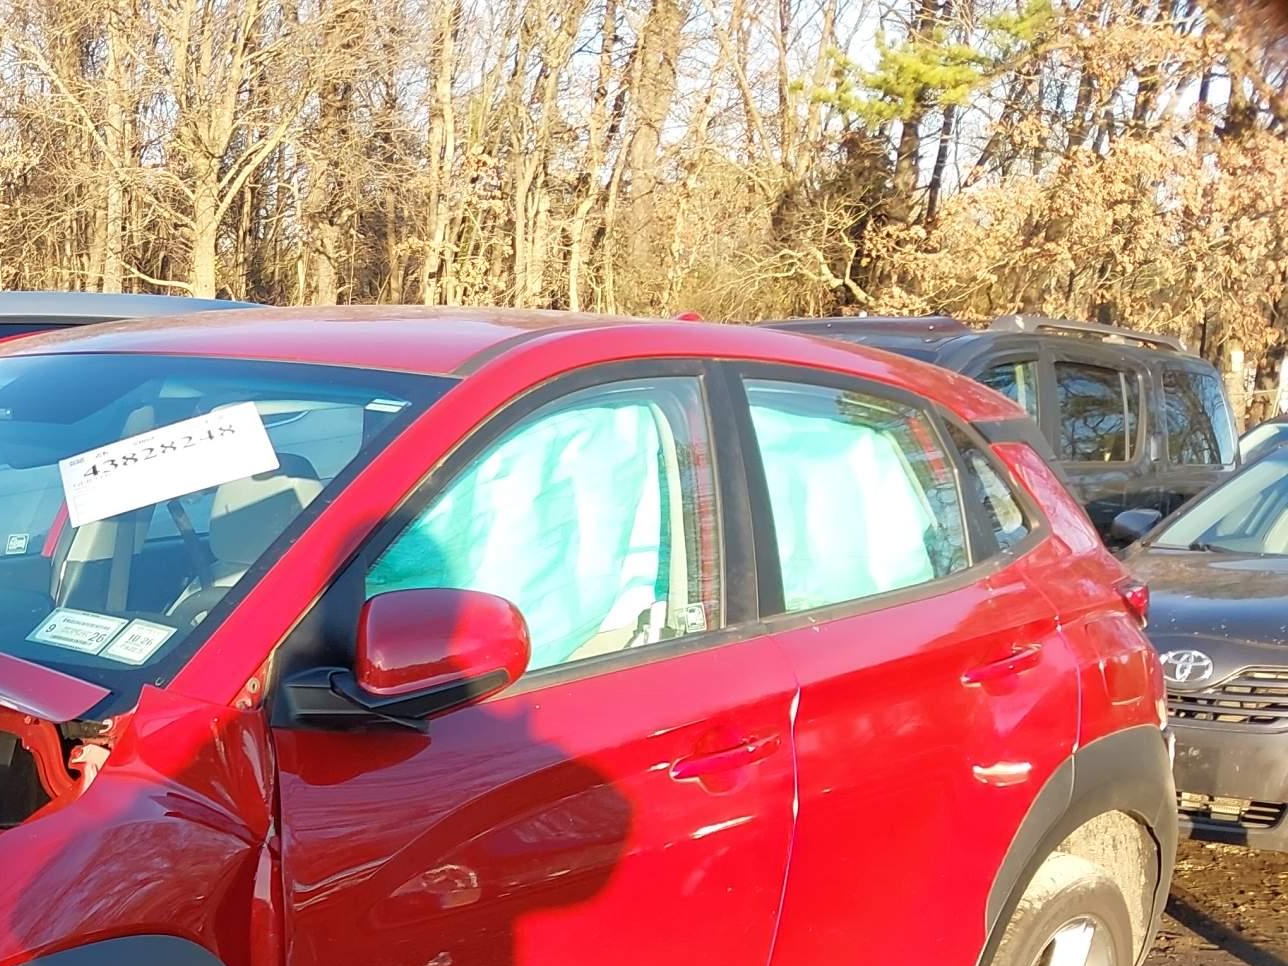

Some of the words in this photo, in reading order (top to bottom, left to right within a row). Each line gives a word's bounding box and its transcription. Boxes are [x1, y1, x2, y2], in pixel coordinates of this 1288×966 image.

[83, 424, 235, 478] 43828248
[45, 623, 57, 633] 9
[88, 631, 108, 643] 26
